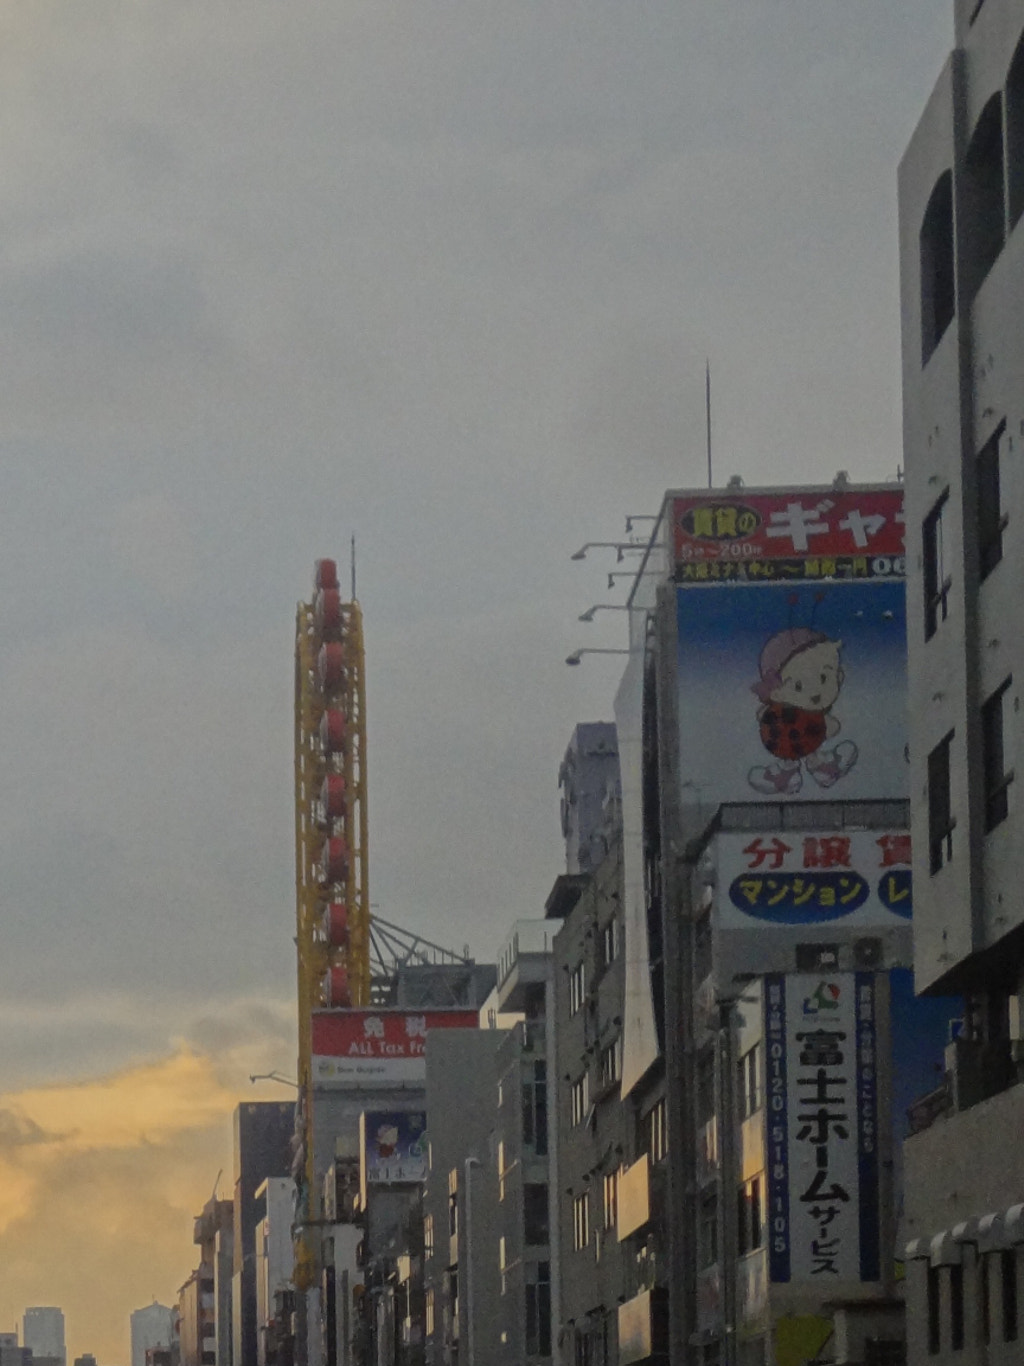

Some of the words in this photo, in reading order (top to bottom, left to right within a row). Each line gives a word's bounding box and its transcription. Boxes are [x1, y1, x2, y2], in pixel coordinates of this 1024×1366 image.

[766, 499, 905, 552] ギャ
[739, 878, 863, 906] マンション
[795, 1028, 850, 1275] 富士ホームサービス
